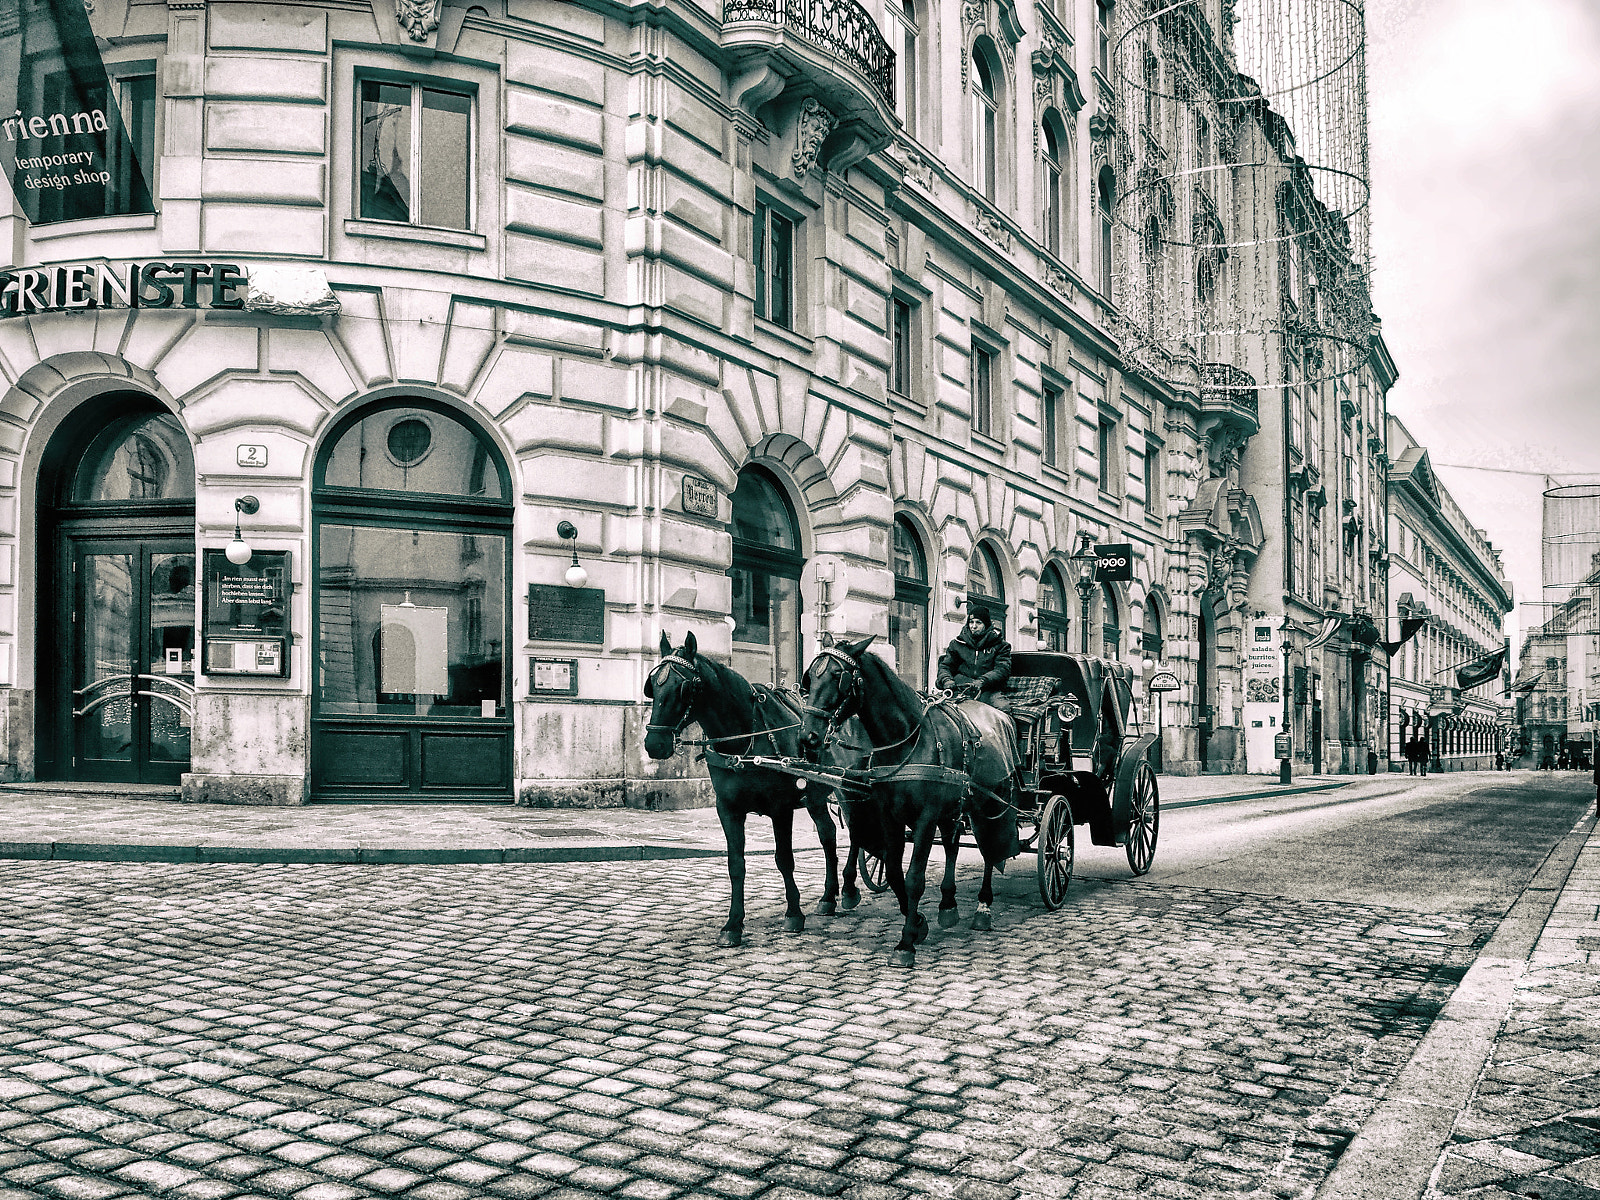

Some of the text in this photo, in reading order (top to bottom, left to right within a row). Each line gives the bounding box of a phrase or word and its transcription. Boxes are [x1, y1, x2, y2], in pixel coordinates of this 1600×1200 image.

[2, 109, 110, 142] rienna
[15, 151, 94, 171] temporary
[24, 168, 111, 190] design shop
[247, 447, 258, 460] 2
[1098, 557, 1127, 569] 1900
